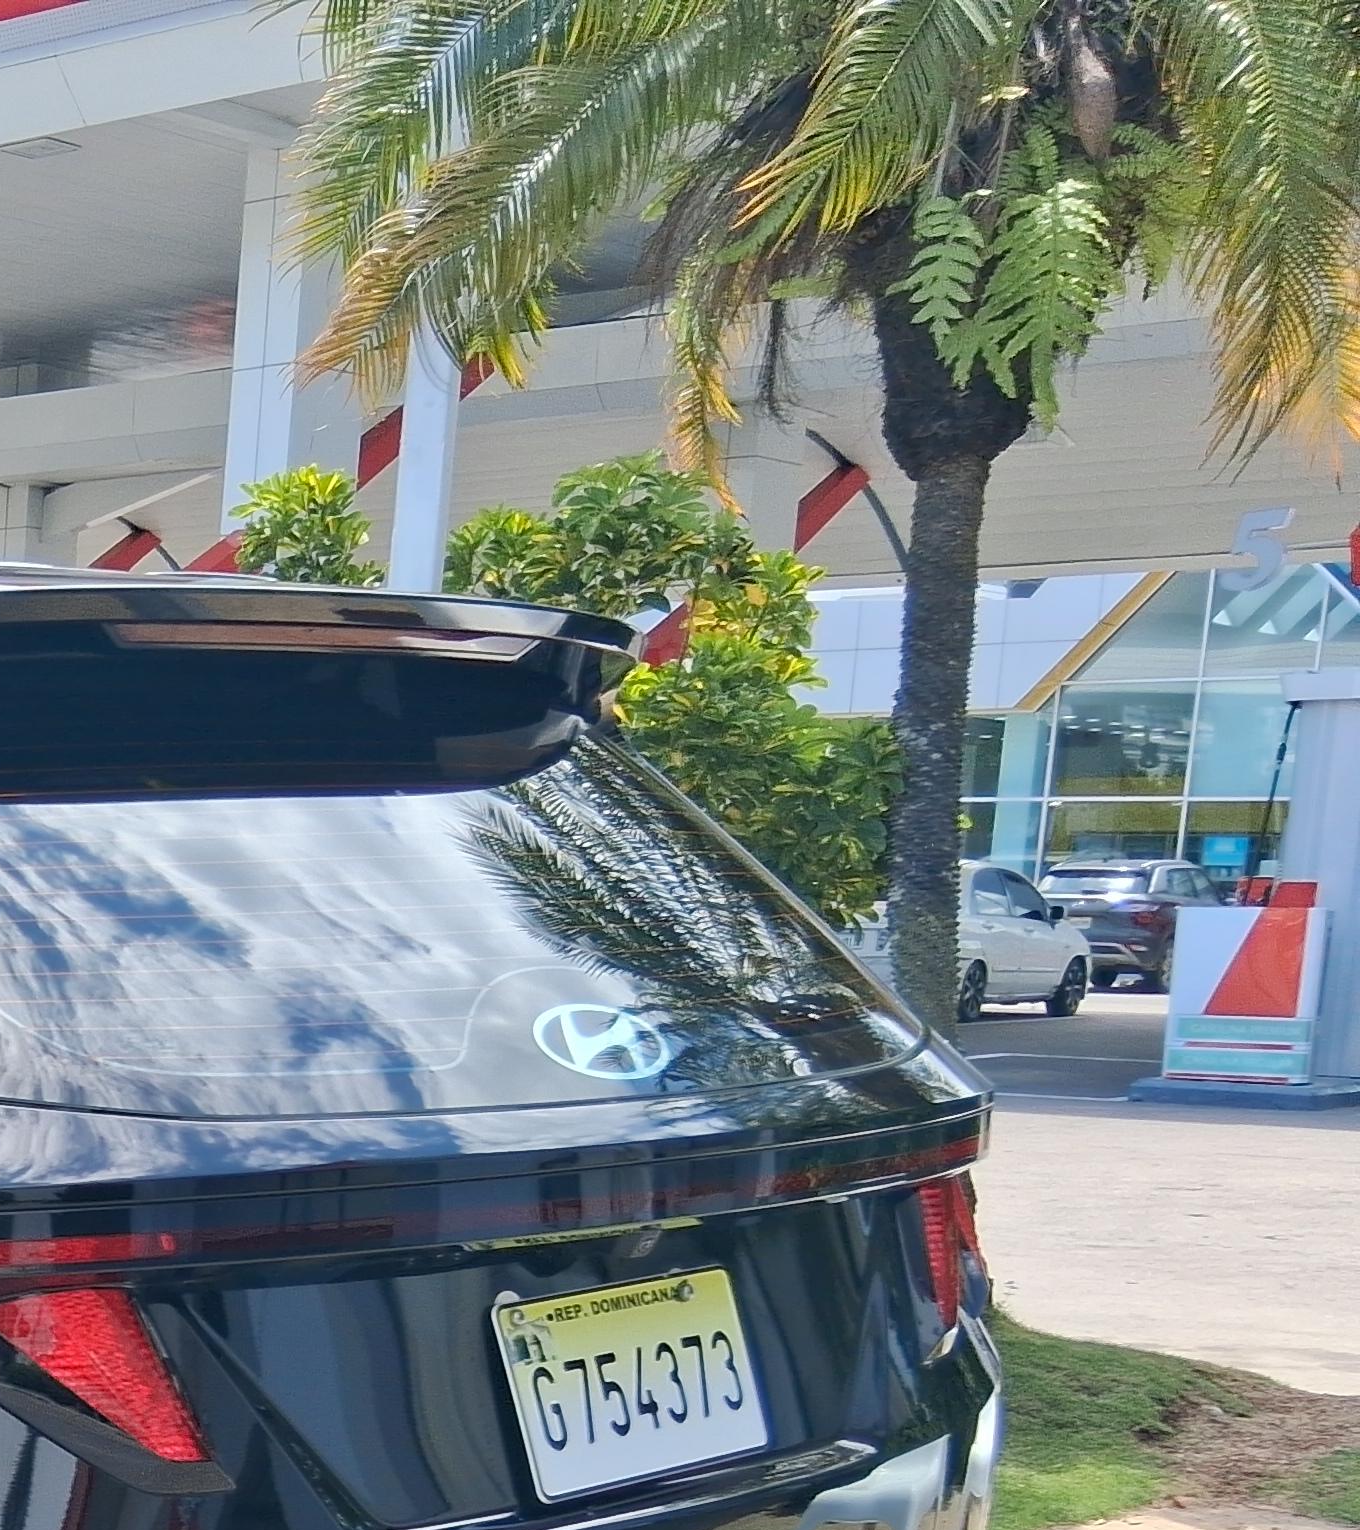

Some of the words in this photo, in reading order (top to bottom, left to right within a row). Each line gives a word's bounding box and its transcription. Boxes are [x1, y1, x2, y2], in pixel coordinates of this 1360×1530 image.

[1220, 506, 1296, 592] 5
[555, 1304, 589, 1322] REP.
[532, 1330, 744, 1452] G754373
